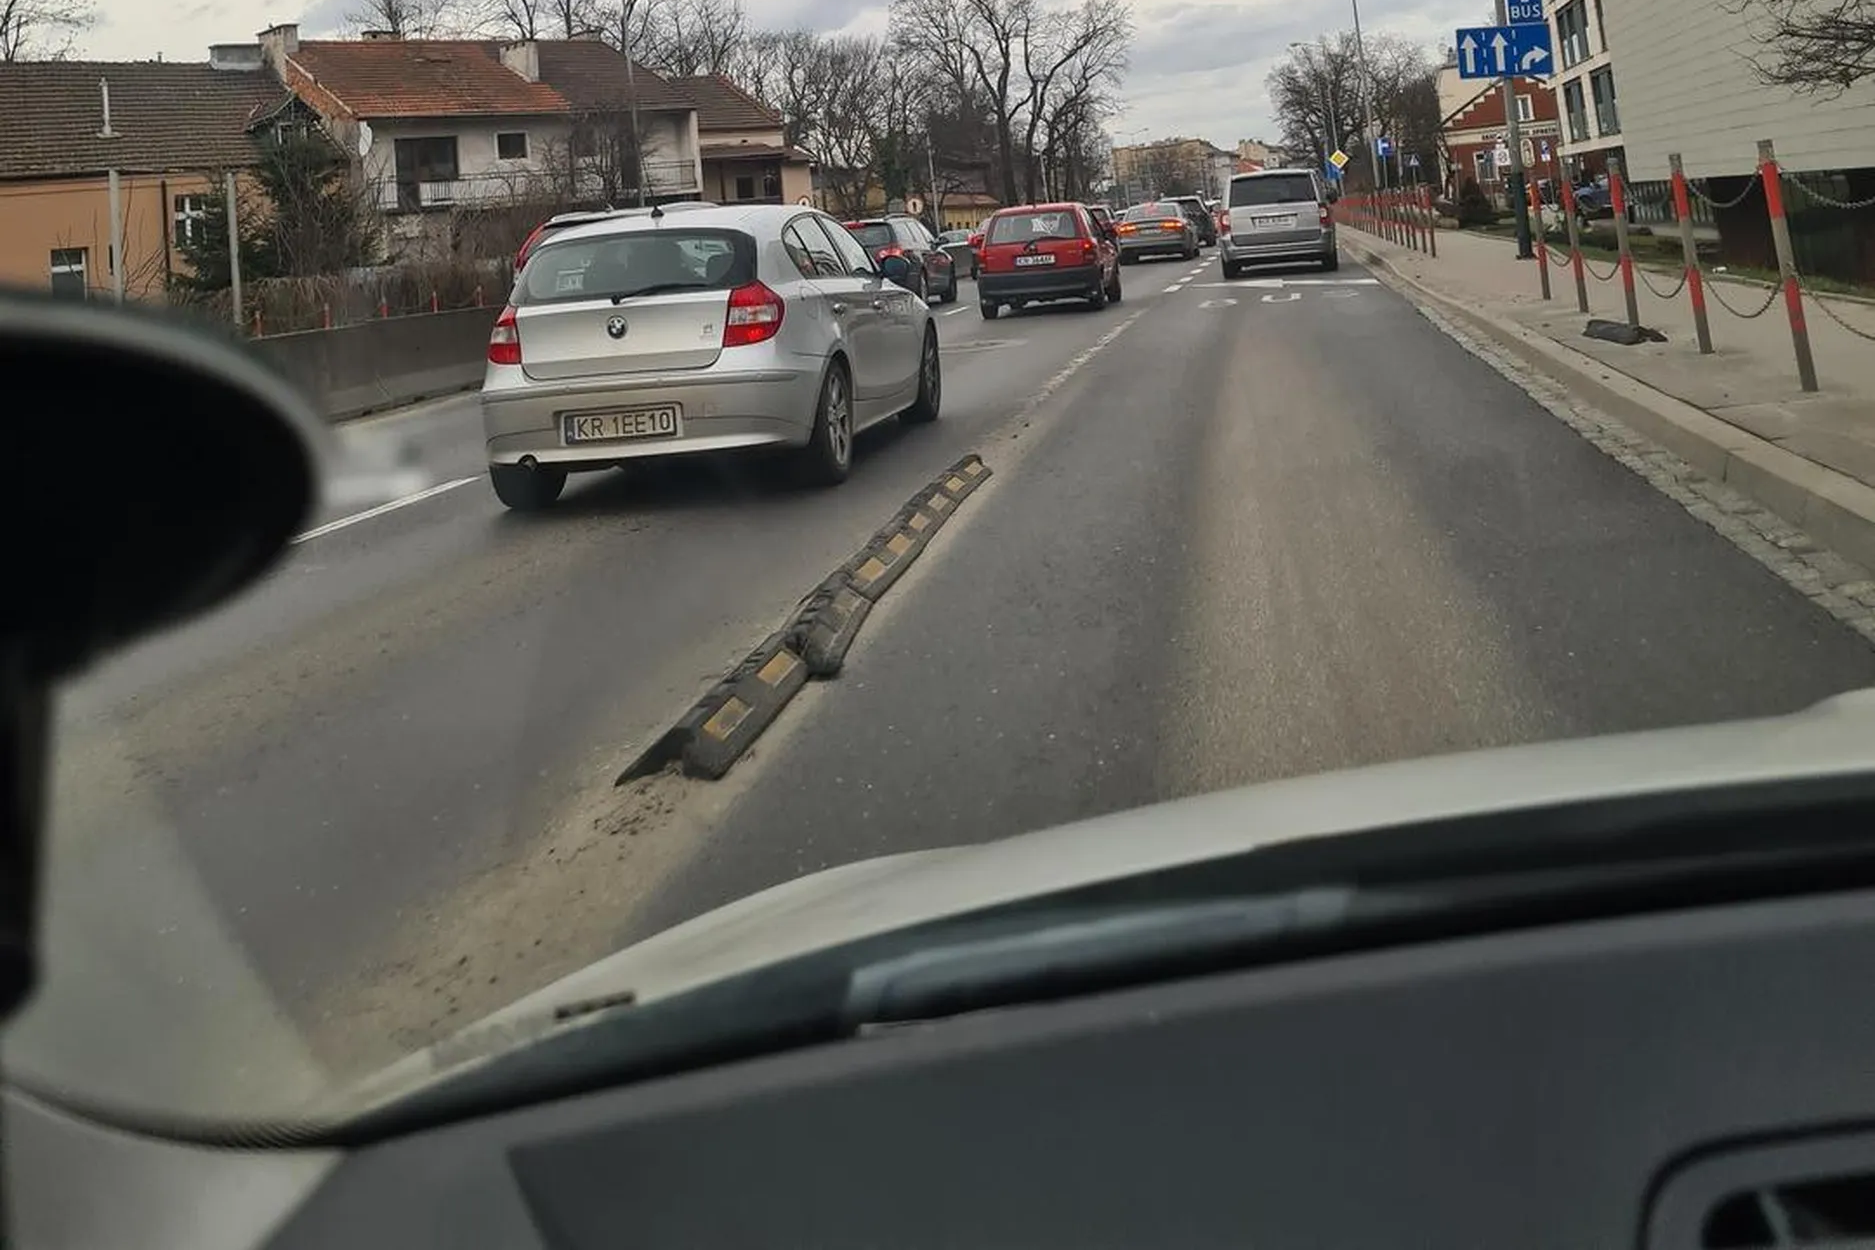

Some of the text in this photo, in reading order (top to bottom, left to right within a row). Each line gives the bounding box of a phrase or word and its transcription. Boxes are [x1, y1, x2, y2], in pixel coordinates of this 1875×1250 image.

[1510, 4, 1541, 18] BUS
[576, 412, 671, 438] KR 1EE10
